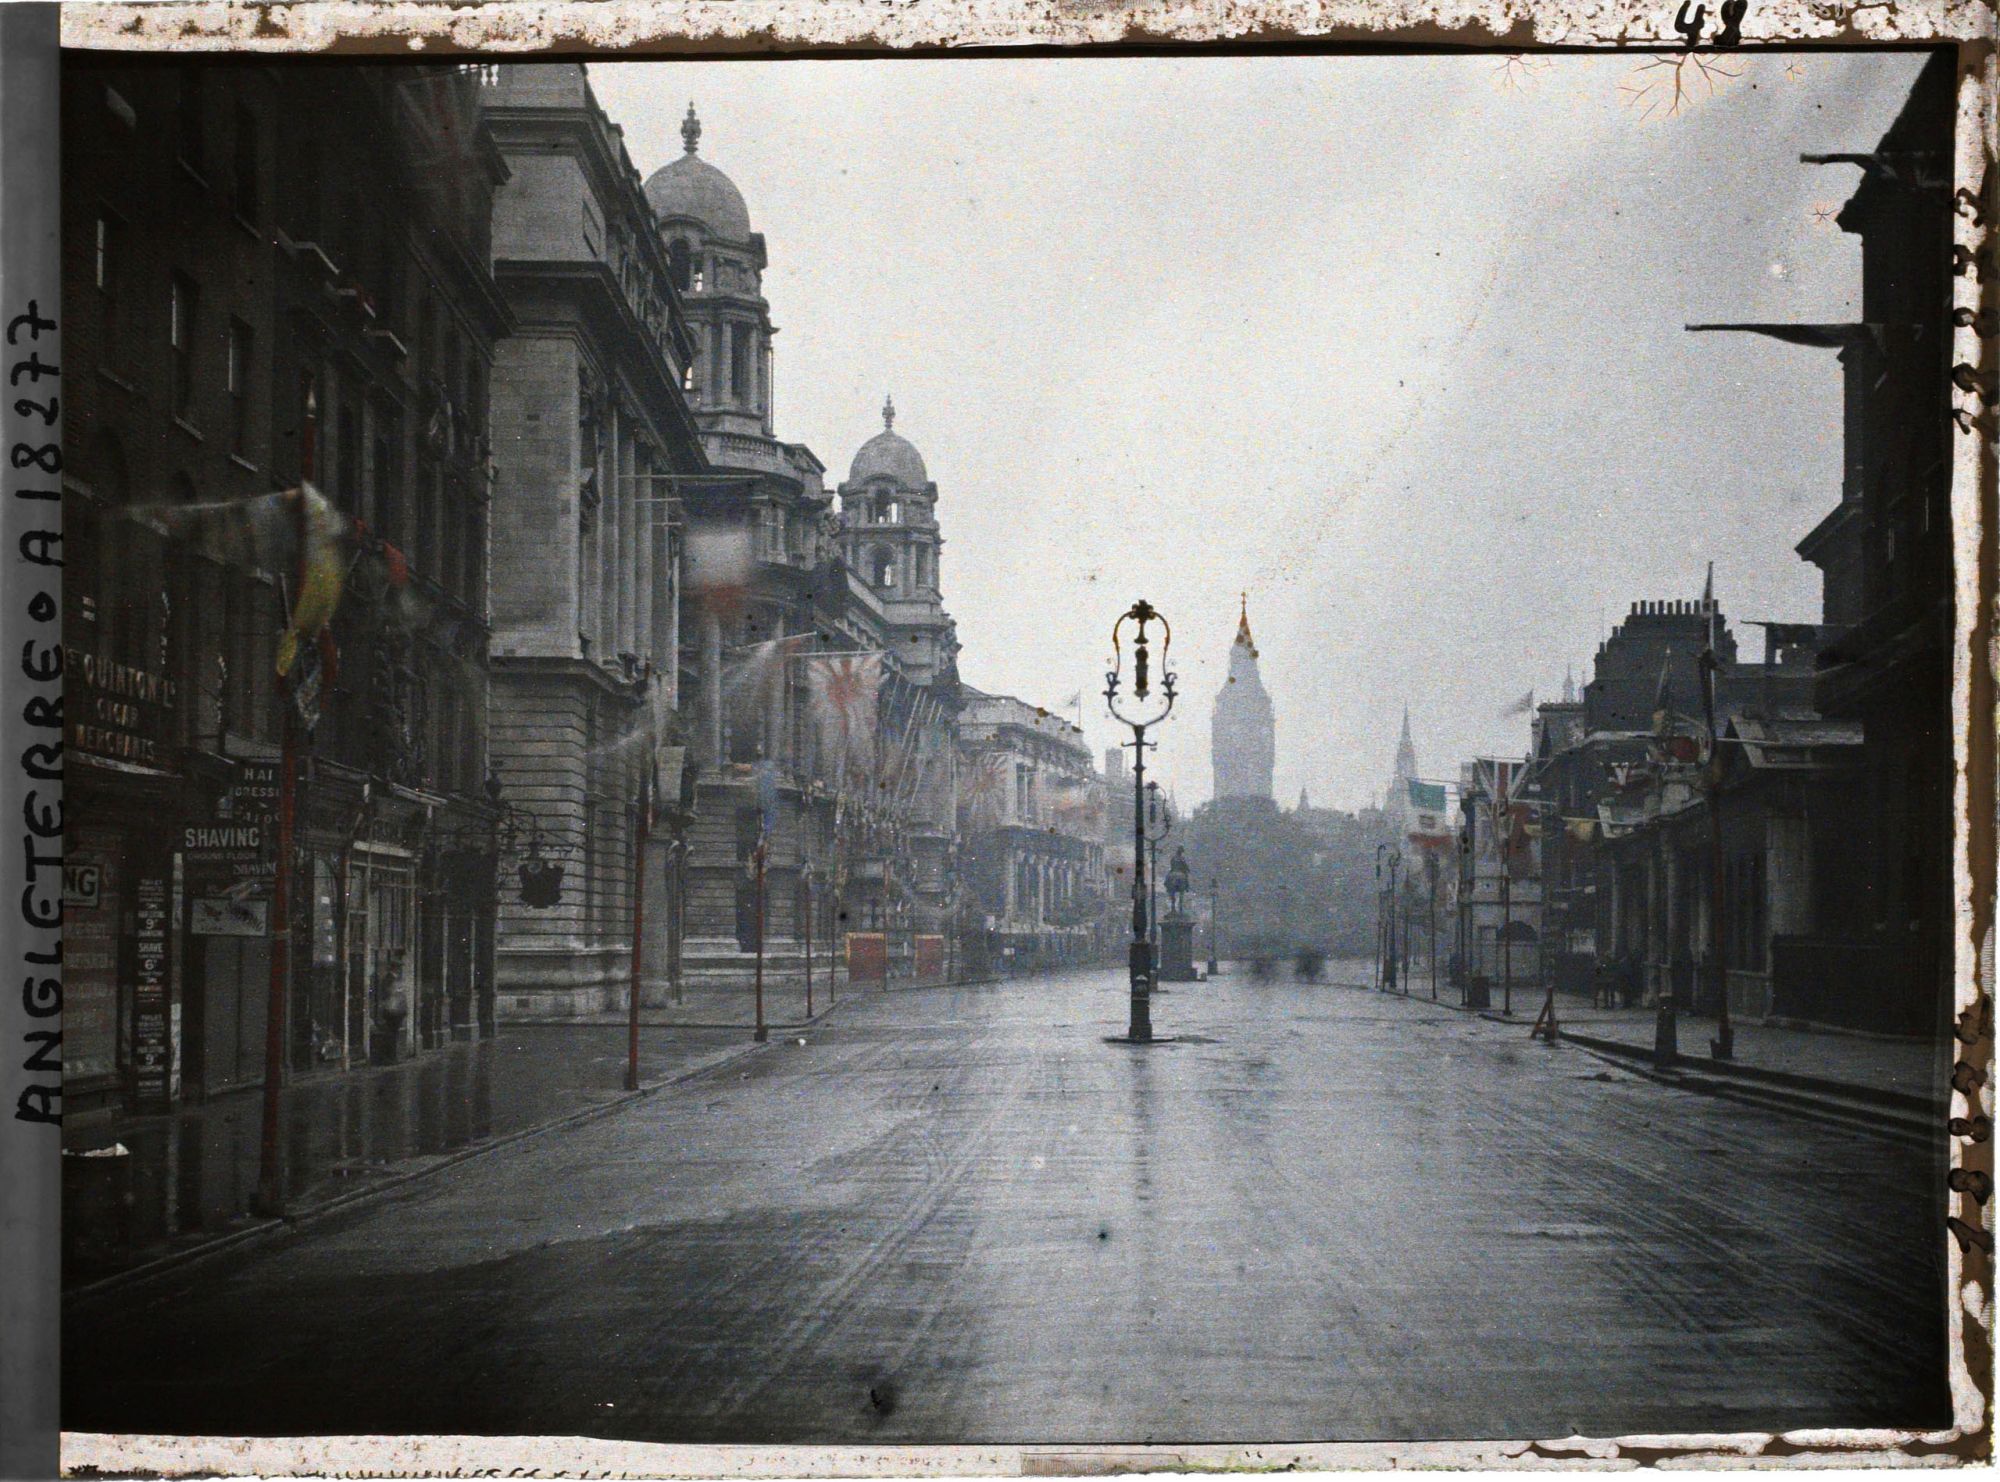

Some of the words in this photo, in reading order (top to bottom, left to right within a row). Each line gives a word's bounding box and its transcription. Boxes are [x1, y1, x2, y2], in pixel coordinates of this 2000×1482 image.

[244, 768, 273, 781] HAI
[235, 787, 280, 798] DRESSI
[185, 827, 260, 848] SHAVING
[15, 639, 63, 1124] ANGLETERRE
